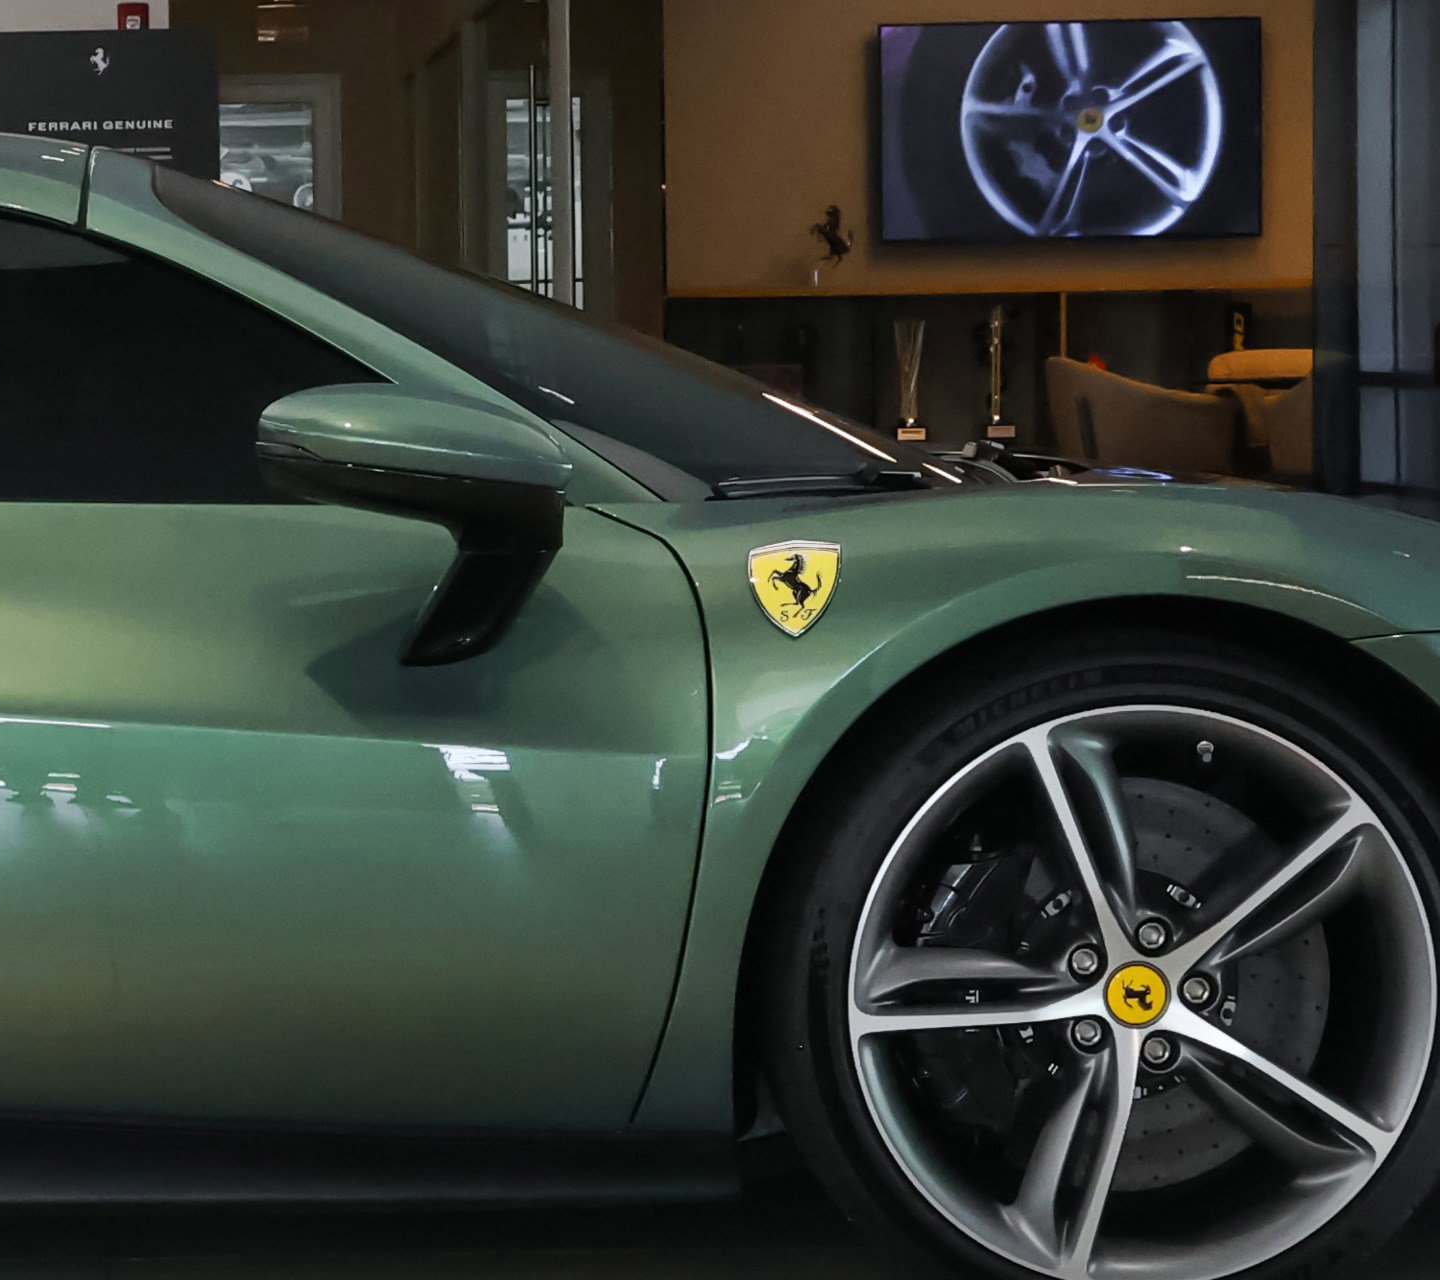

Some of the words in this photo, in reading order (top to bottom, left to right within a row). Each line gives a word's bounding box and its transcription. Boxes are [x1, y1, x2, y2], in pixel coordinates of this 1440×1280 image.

[27, 120, 98, 132] FERRARI
[102, 119, 174, 131] GENUINE
[780, 610, 789, 622] S
